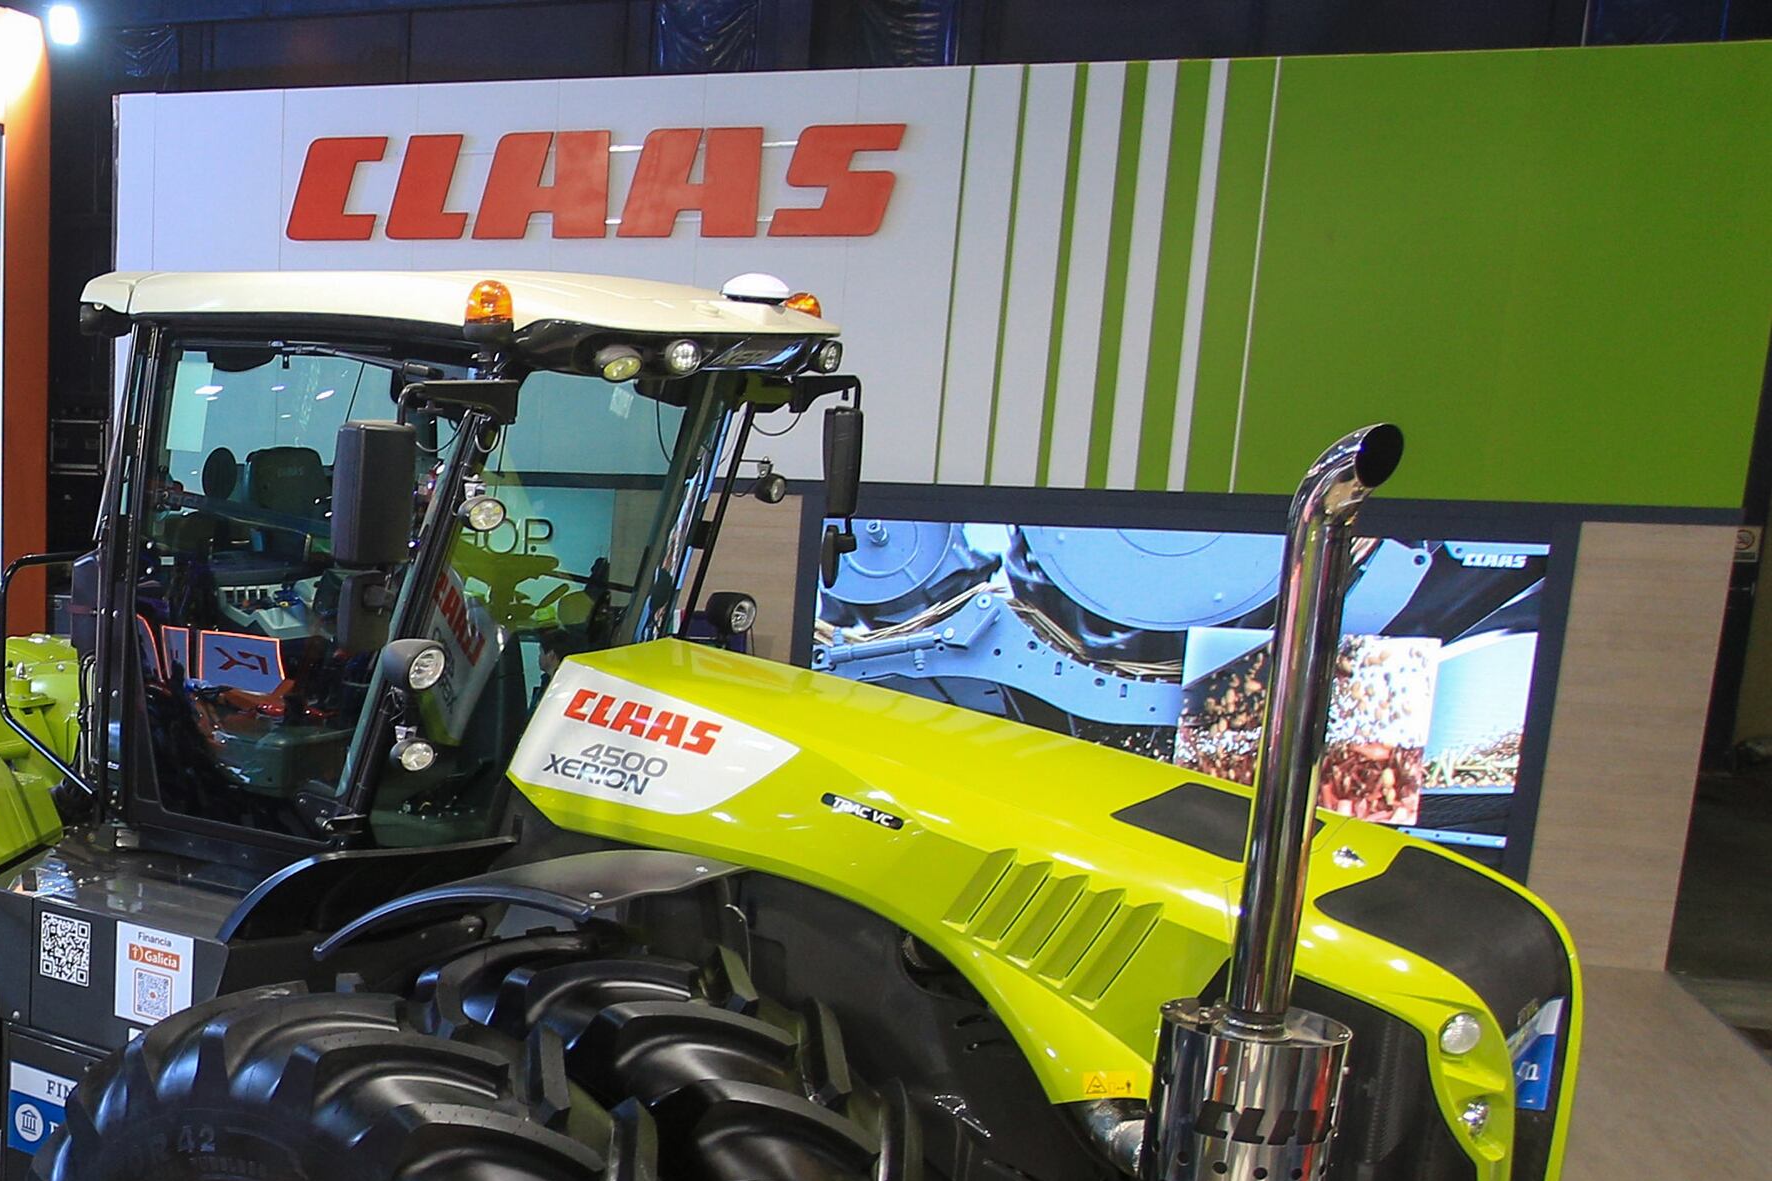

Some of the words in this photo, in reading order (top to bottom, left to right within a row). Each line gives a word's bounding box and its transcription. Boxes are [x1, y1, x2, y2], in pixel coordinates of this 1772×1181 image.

[285, 123, 907, 241] CLAAS
[1462, 553, 1528, 569] CLAAS
[563, 688, 723, 756] CLAAS
[542, 753, 650, 796] XERION
[580, 743, 668, 778] 4500
[832, 796, 871, 818] TRAC
[872, 810, 894, 826] VC
[138, 931, 172, 948] Financia
[144, 950, 178, 969] Galicia
